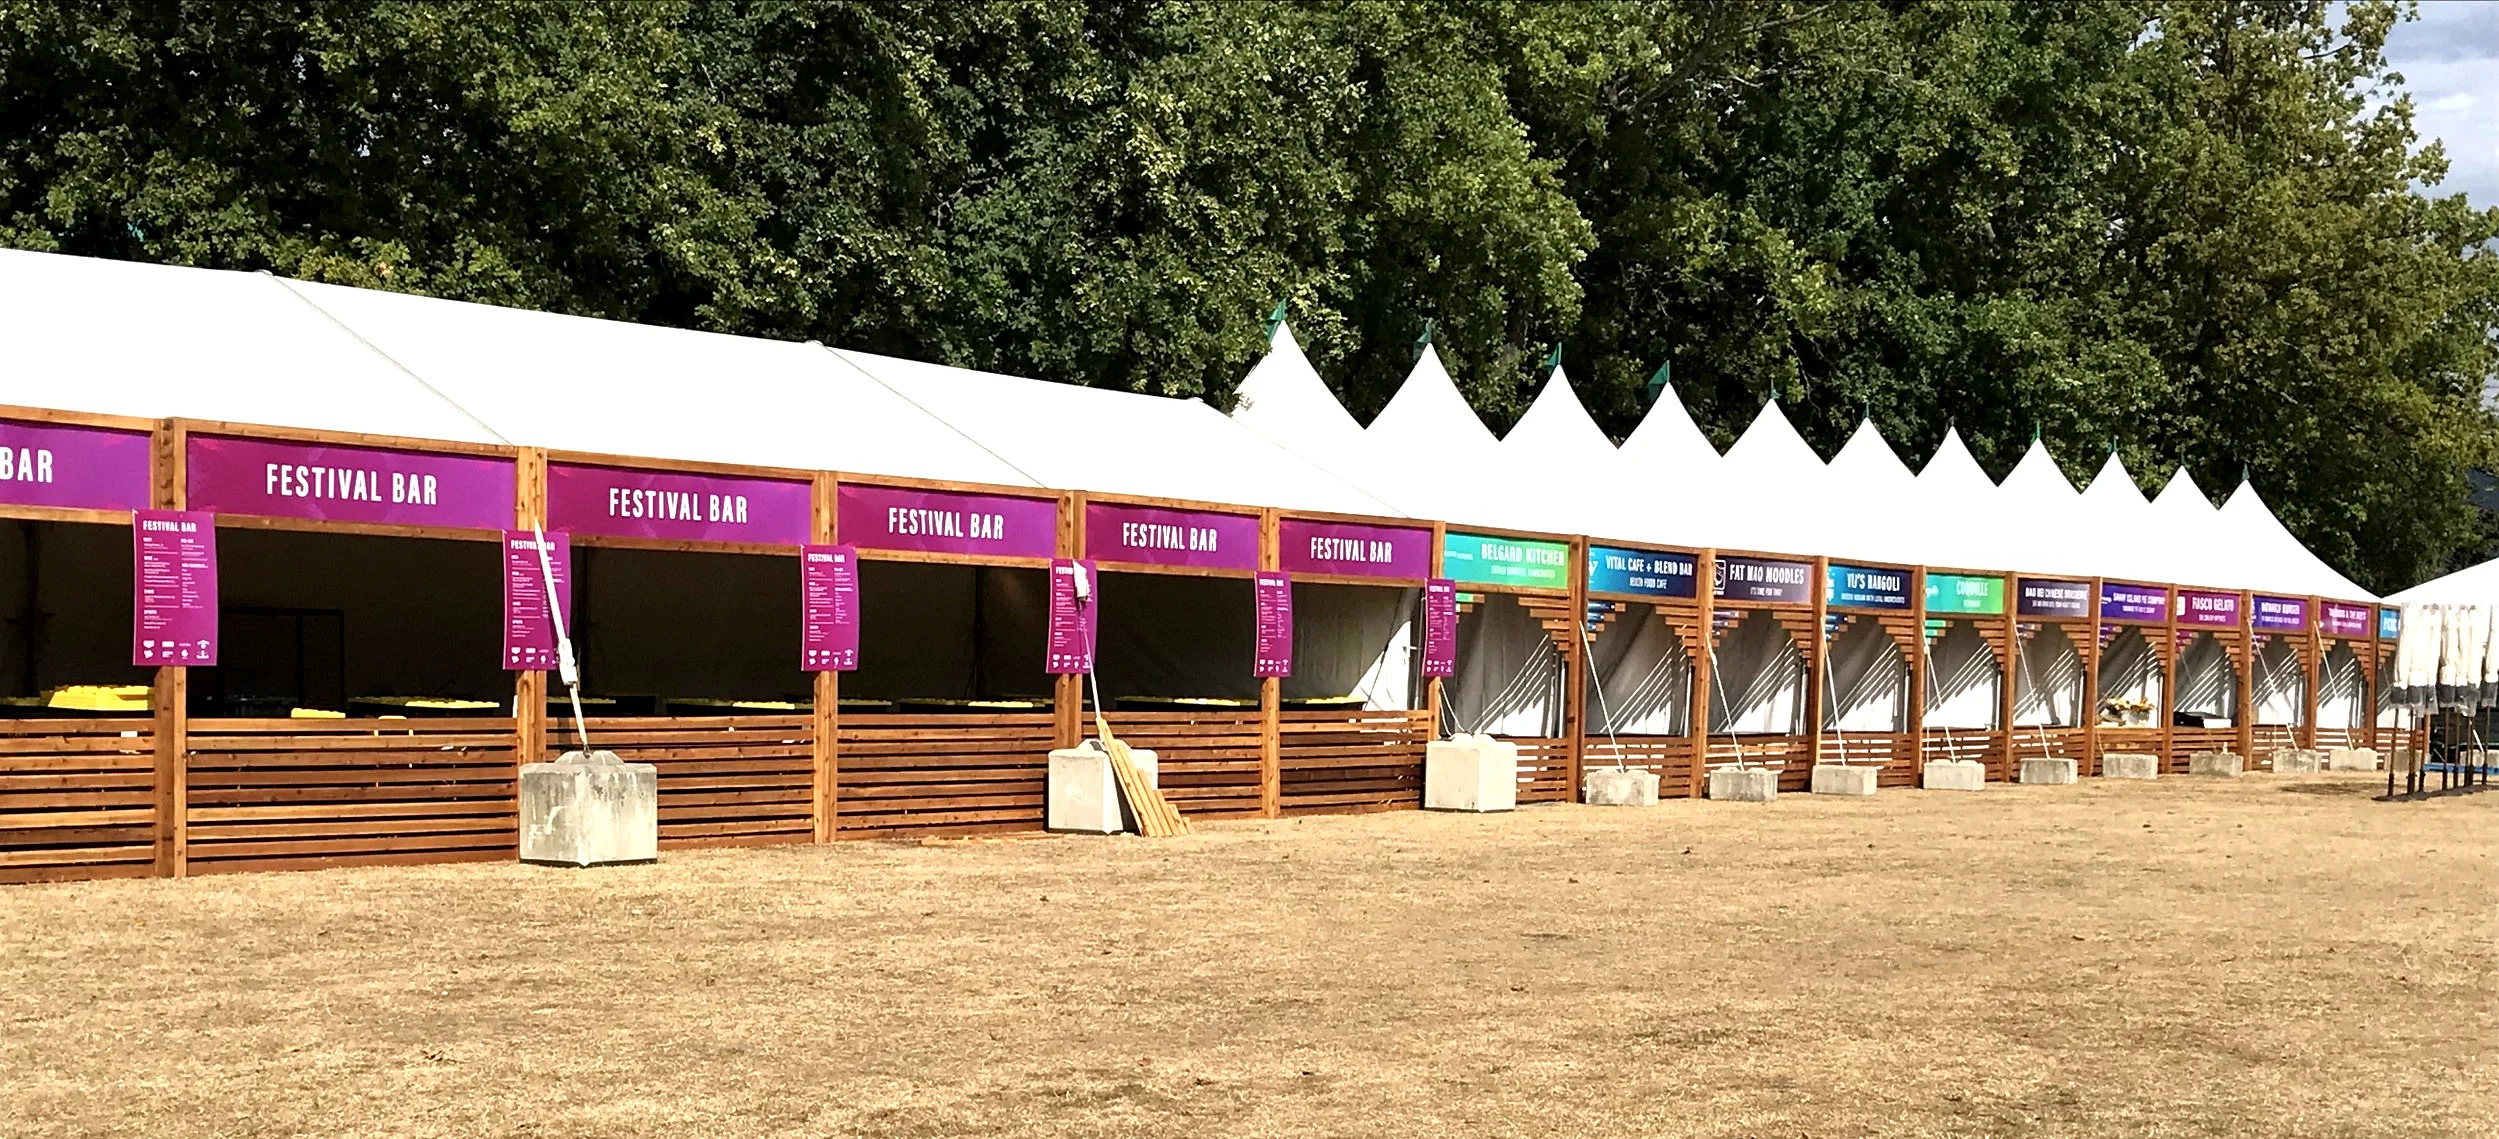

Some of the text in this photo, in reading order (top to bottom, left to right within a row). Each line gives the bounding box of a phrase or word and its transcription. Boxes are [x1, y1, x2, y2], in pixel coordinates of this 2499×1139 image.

[0, 446, 53, 484] BAR
[267, 464, 437, 505] FESTIVAL BAR
[609, 487, 748, 524] FESTIVAL BAR
[143, 520, 197, 533] FESTIVAL BAR
[888, 507, 1004, 540] FESTIVAL BAR
[1122, 523, 1218, 552] FESTIVAL BAR
[808, 553, 833, 563] FESTIVAL
[1310, 537, 1393, 563] FESTIVAL BAR
[1481, 543, 1522, 562] BELGARD
[1526, 547, 1565, 567] KITCHEN
[1605, 555, 1693, 577] VITAL CAFE + BLEND BAR
[1729, 563, 1805, 585] FAT MAO NOODLES
[1867, 574, 1900, 592] RANGOLI
[2213, 597, 2234, 612] GELATO
